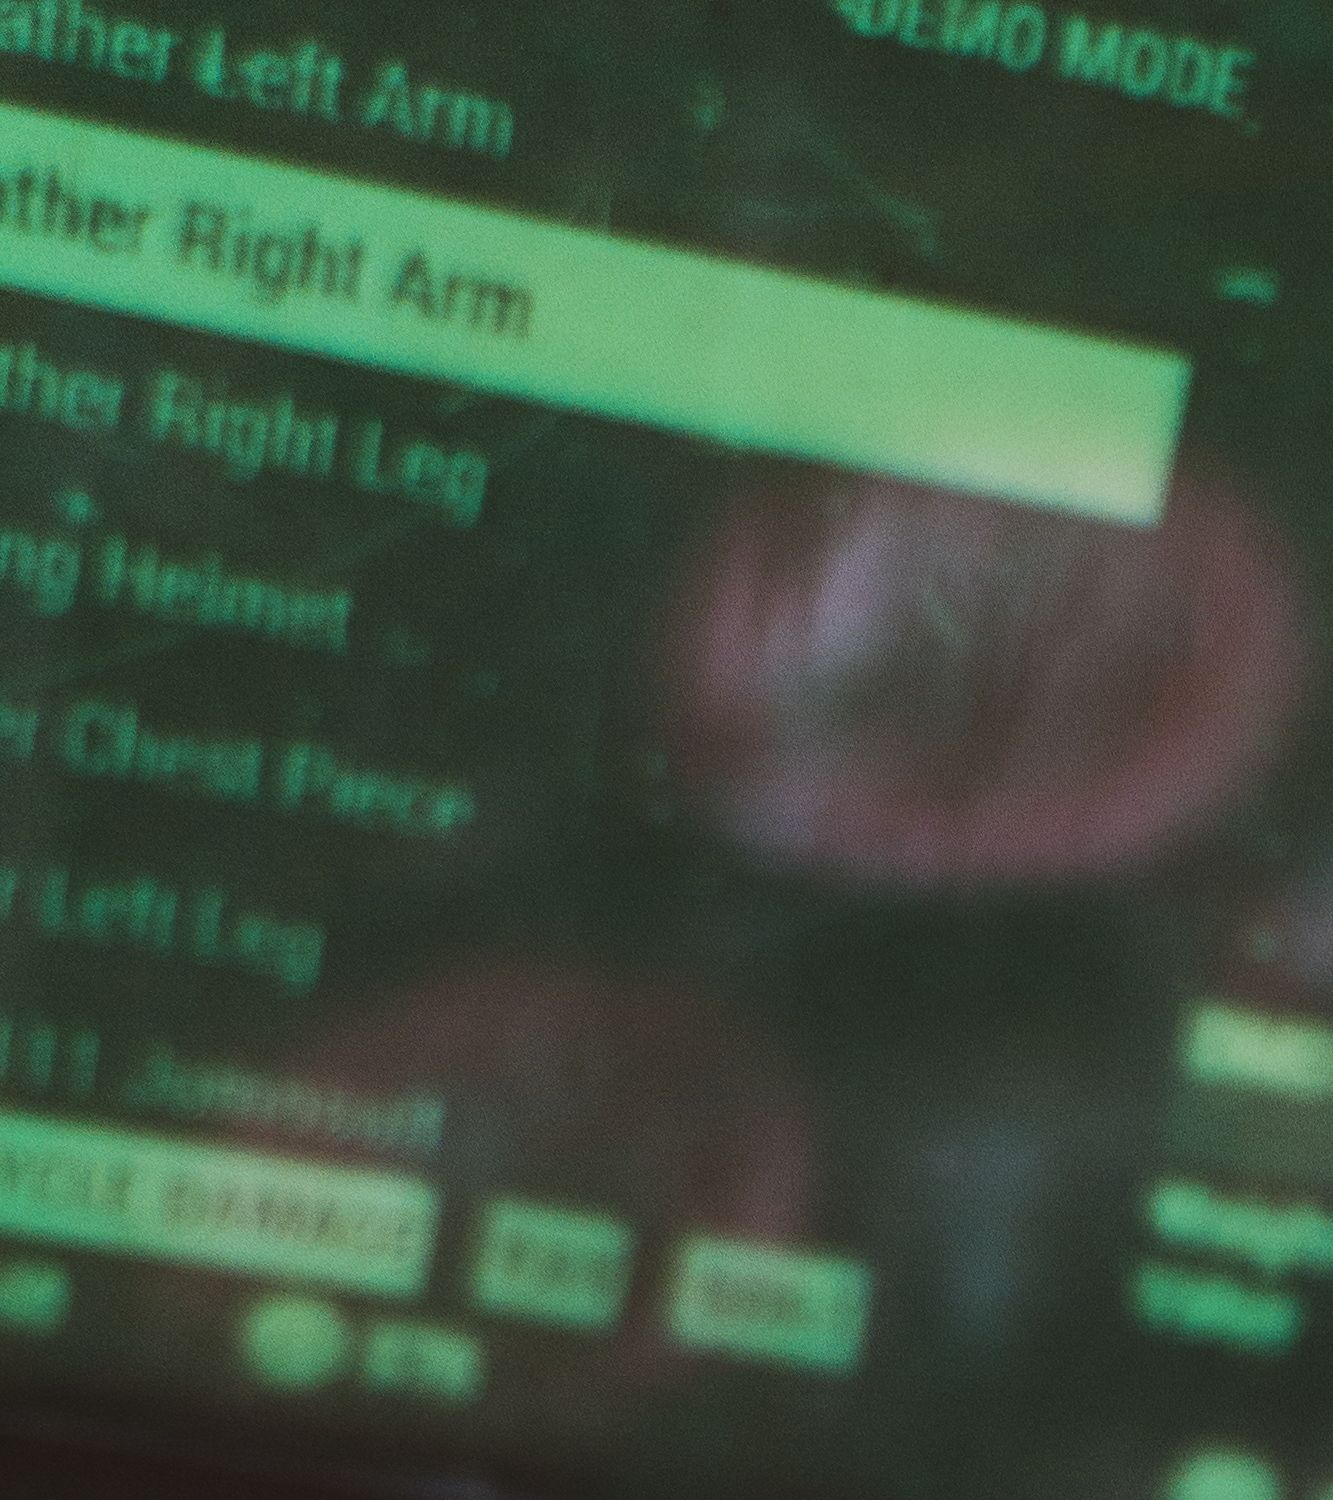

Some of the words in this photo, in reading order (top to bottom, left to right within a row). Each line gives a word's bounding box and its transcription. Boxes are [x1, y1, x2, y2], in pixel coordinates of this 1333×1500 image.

[193, 22, 343, 123] Left
[360, 58, 514, 157] Arm
[1056, 14, 1256, 120] MODE
[0, 163, 150, 260] ther
[176, 200, 363, 309] Right
[390, 245, 537, 341] Arm
